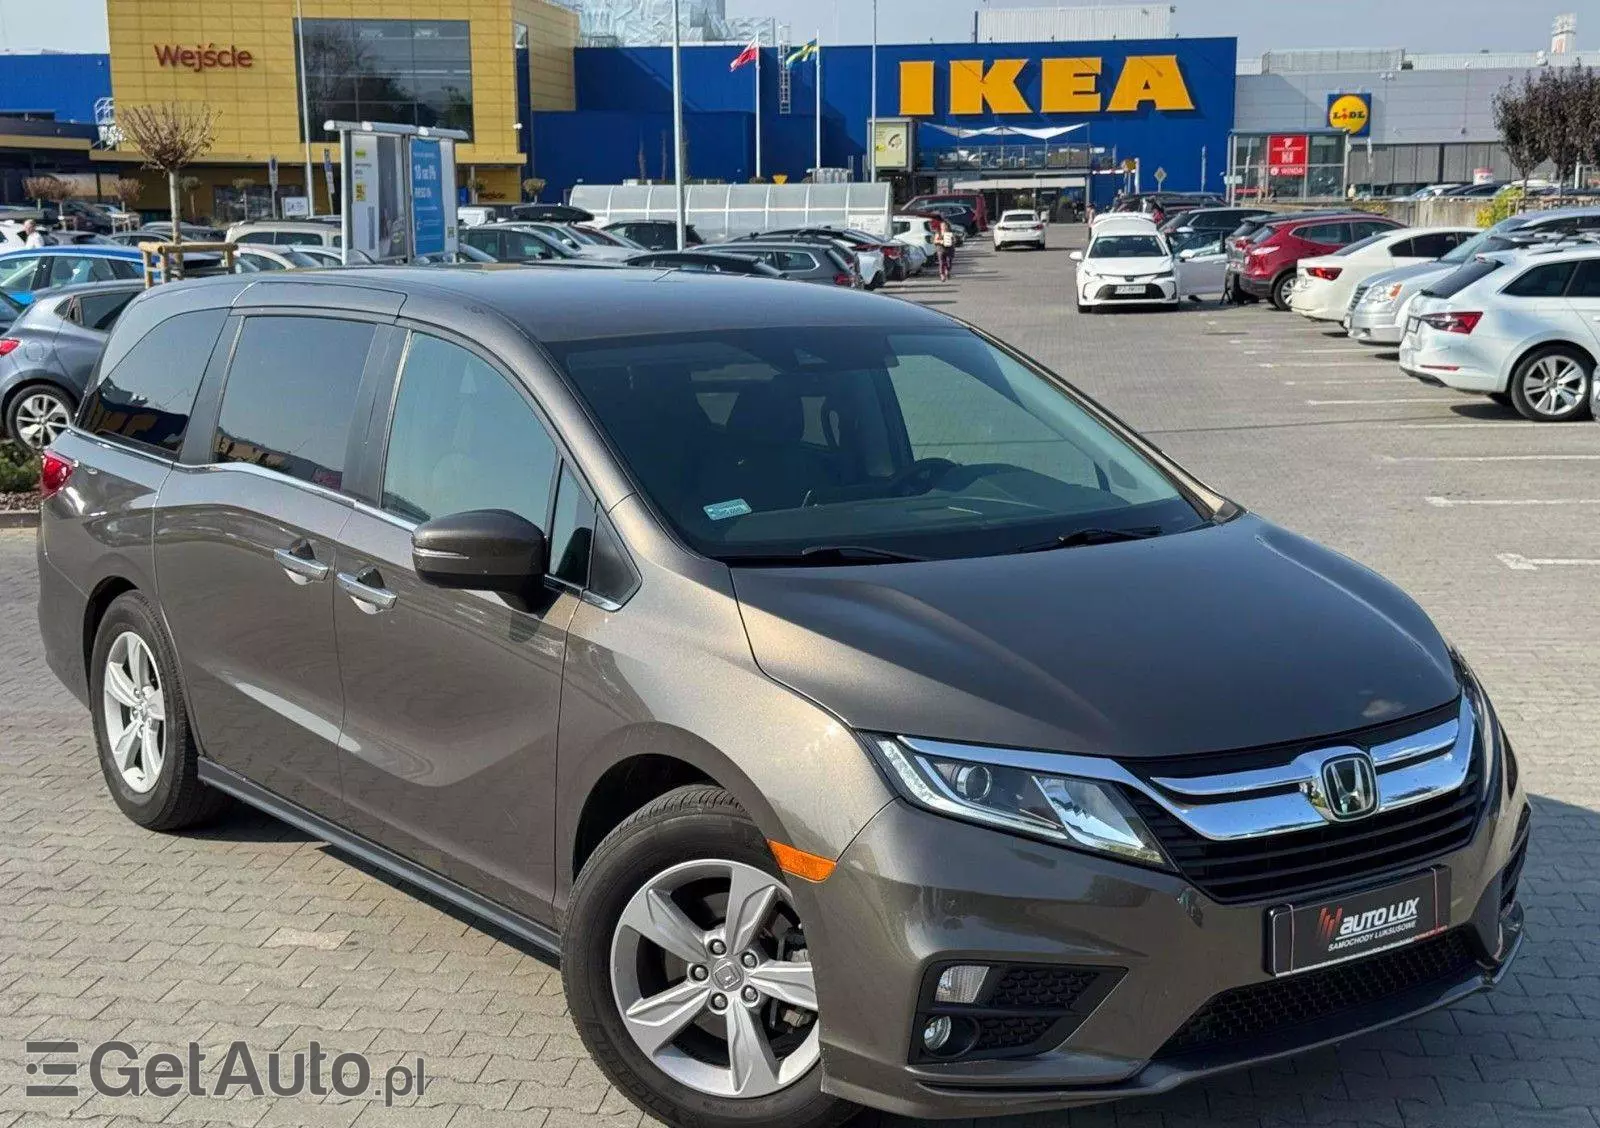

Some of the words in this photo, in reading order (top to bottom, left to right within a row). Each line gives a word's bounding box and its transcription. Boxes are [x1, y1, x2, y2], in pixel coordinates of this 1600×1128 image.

[154, 43, 253, 73] Wejście
[899, 55, 1195, 115] IKEA
[1388, 897, 1420, 921] LUX
[1328, 934, 1374, 952] SAMOCHODY
[1375, 921, 1416, 938] LUKSUSOWE
